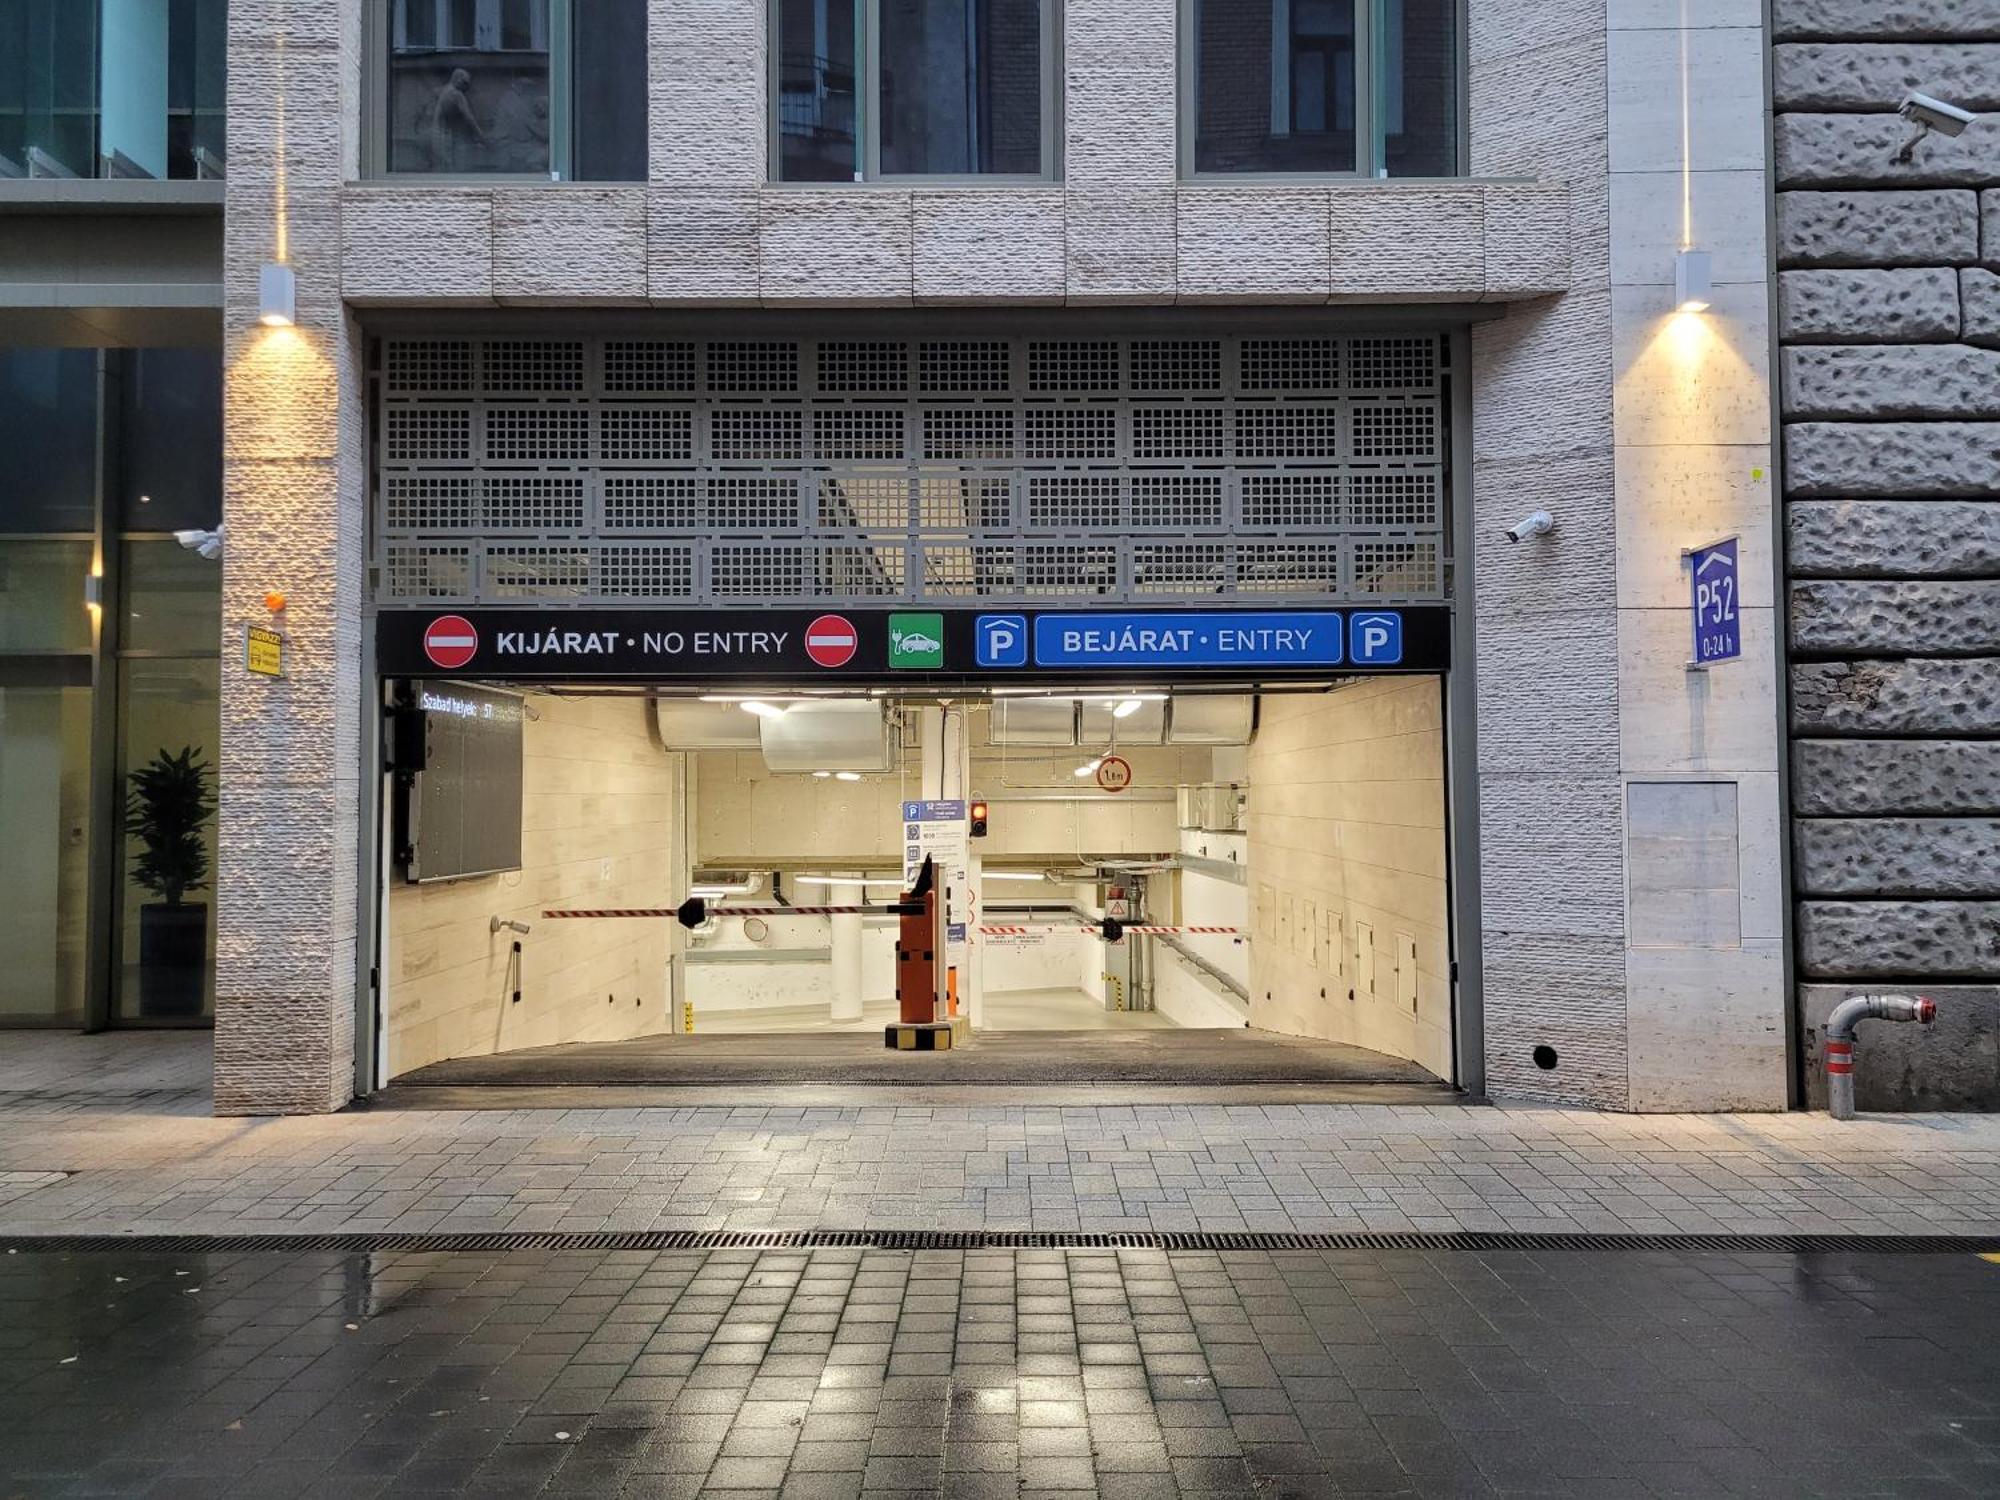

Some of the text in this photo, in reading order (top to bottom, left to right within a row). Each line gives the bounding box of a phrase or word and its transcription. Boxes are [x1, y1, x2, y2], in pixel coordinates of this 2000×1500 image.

[1697, 576, 1734, 627] P52
[497, 627, 788, 653] KIJÁRAT NO ENTRY
[991, 630, 1013, 659] P
[1063, 625, 1313, 651] BEJÁRAT ENTRY
[1365, 628, 1388, 656] P
[1703, 633, 1733, 657] 0-24 h
[423, 692, 451, 712] Szabad
